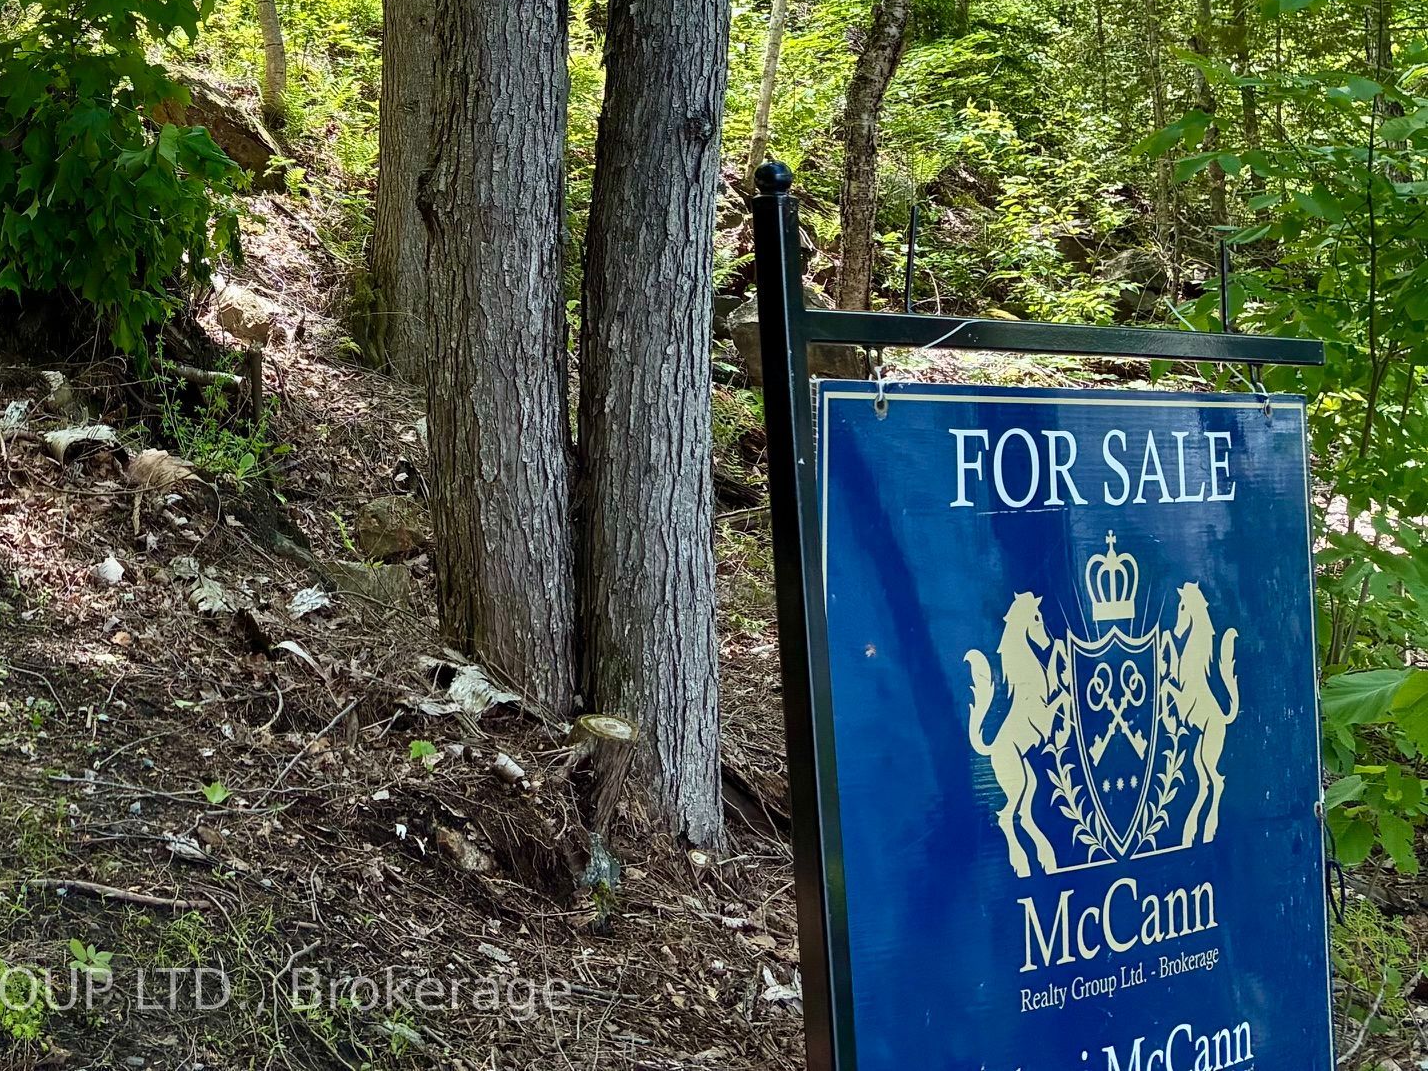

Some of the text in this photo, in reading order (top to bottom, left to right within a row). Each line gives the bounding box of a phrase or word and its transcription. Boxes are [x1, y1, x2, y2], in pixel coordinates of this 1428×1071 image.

[948, 427, 1236, 508] FOR SALE
[1016, 877, 1219, 973] McCann
[1020, 983, 1067, 1013] Realty
[1071, 975, 1117, 1000] Group
[1120, 962, 1147, 989] Ltd.
[1158, 947, 1220, 979] Brokerage
